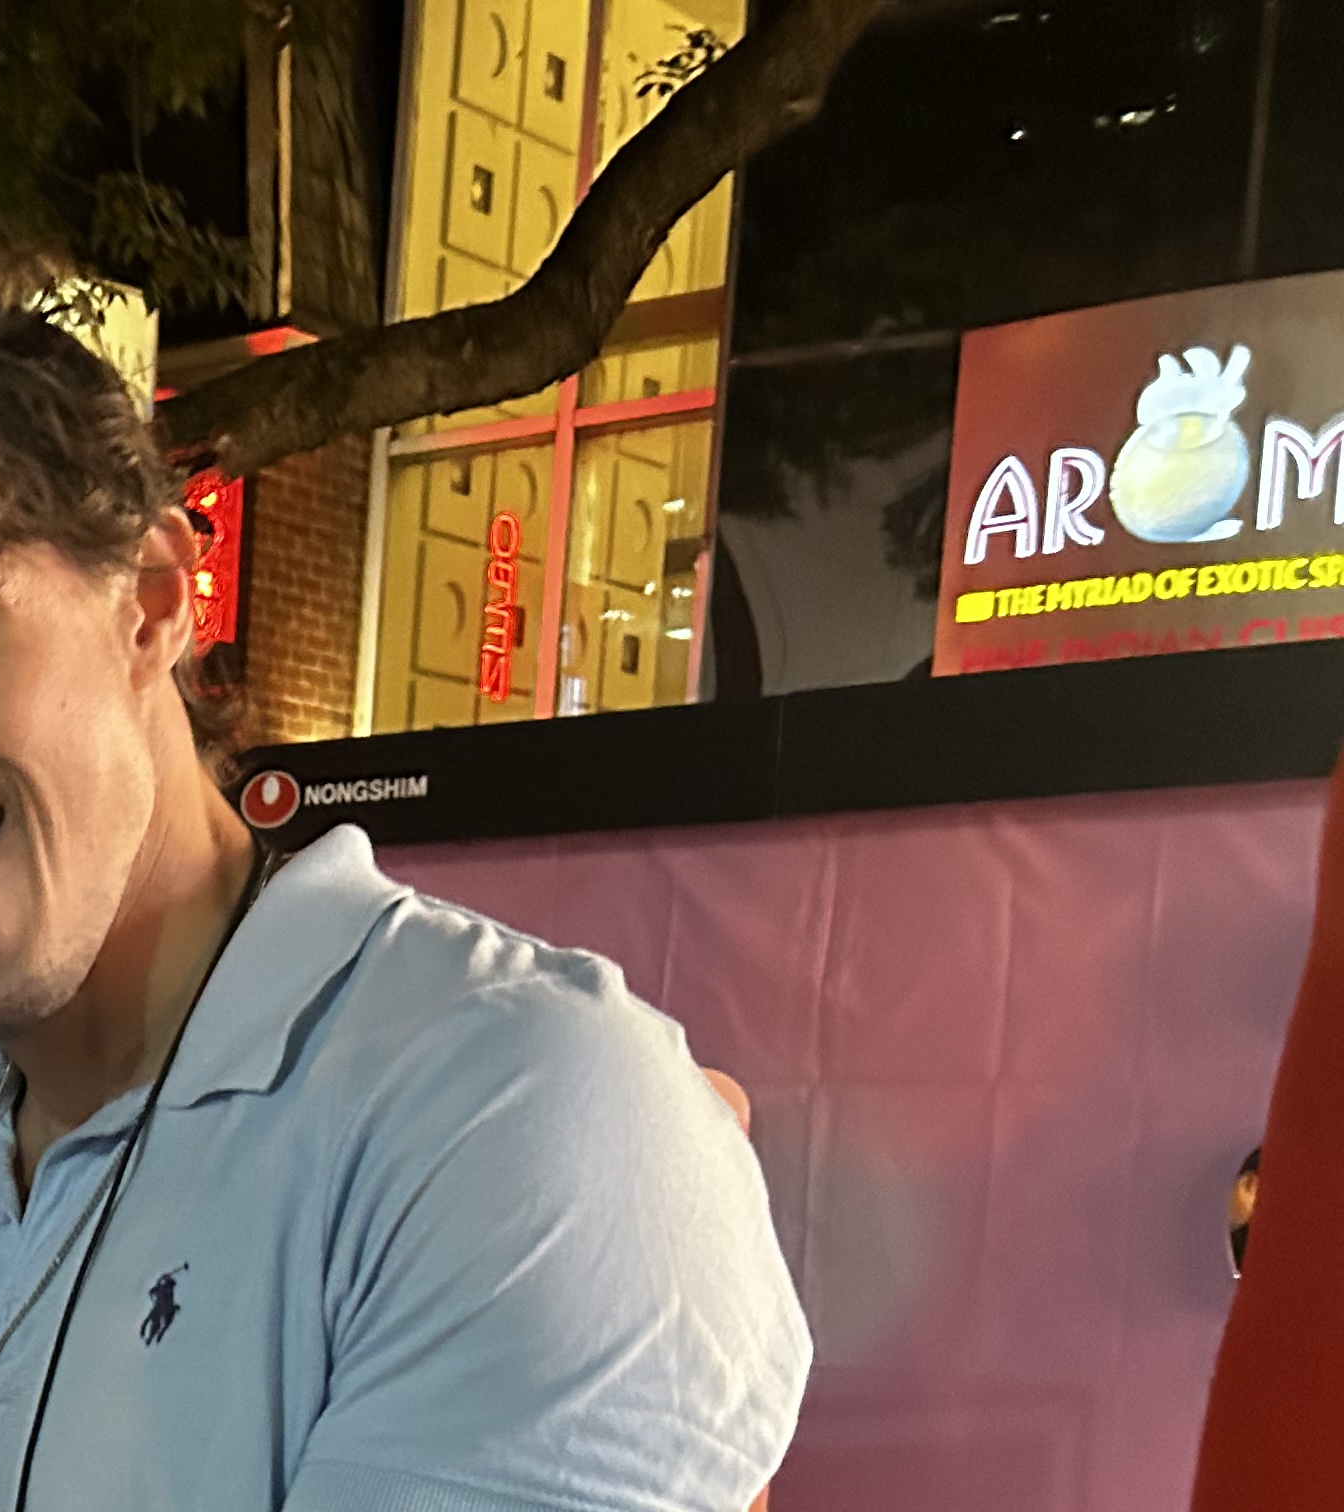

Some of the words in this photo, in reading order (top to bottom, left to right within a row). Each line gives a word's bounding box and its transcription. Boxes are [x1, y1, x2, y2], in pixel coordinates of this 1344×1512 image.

[994, 585, 1047, 618] THE
[1154, 566, 1199, 601] OF
[1196, 557, 1309, 598] EXOTIC
[304, 775, 429, 806] NONGSHIM
